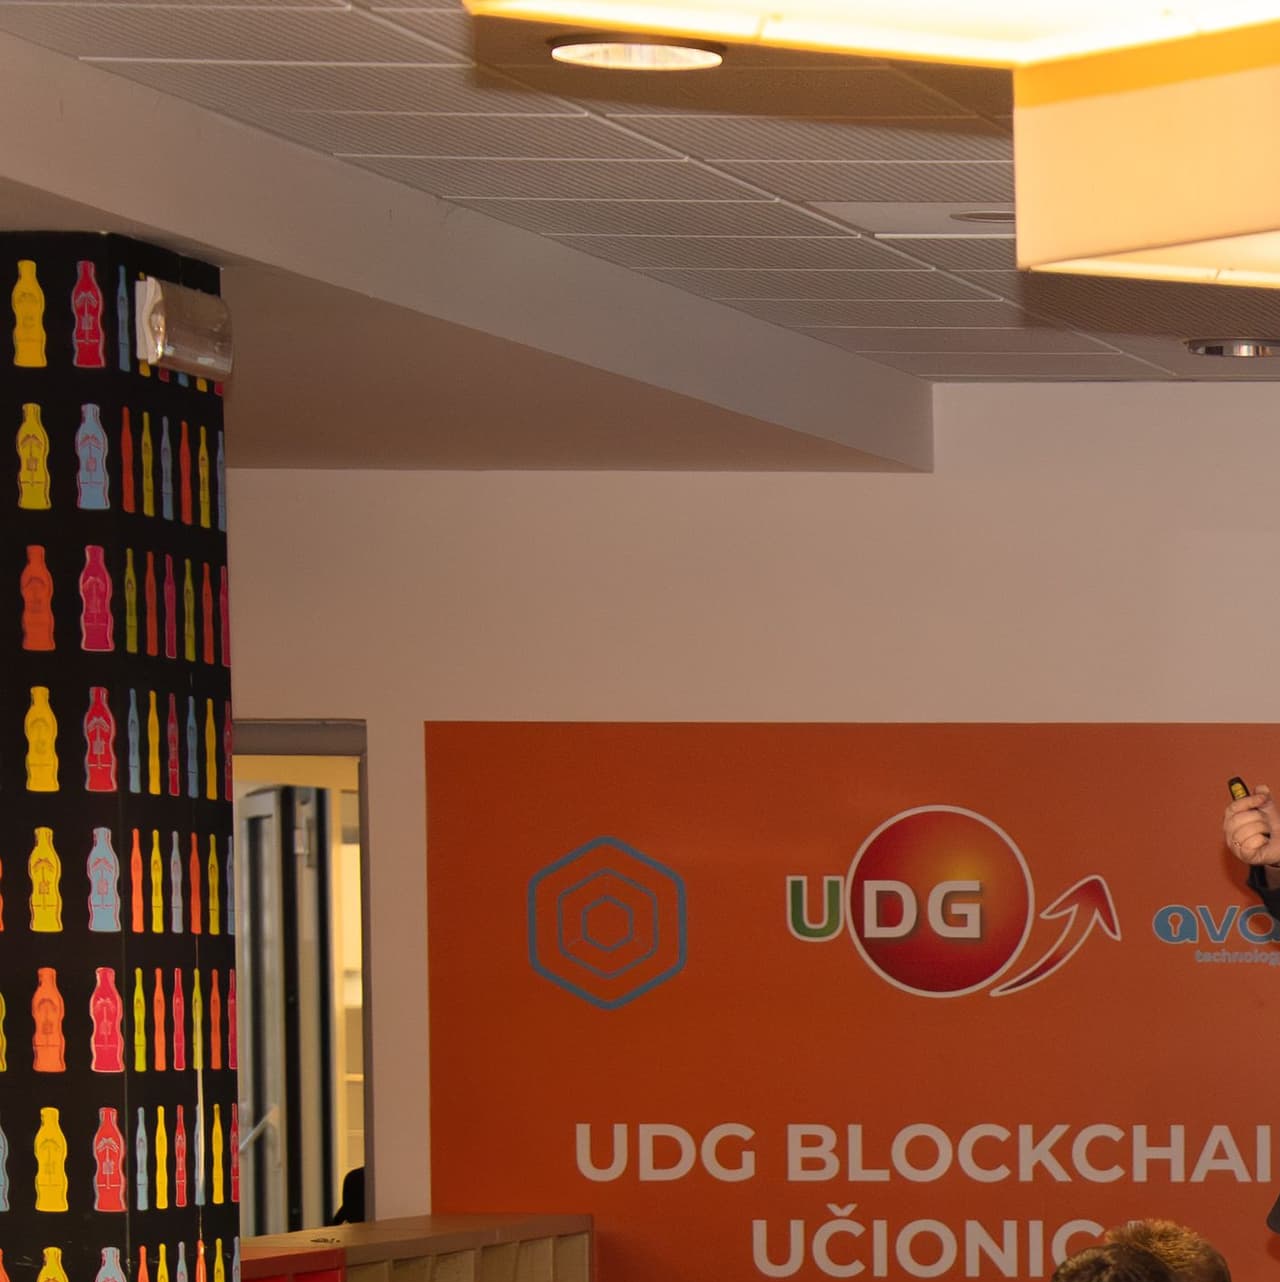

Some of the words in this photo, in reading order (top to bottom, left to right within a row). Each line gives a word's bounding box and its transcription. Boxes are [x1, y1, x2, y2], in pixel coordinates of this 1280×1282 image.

[786, 874, 985, 944] UDG
[576, 1123, 754, 1181] UDG
[753, 1203, 1144, 1279] UČIONIC
